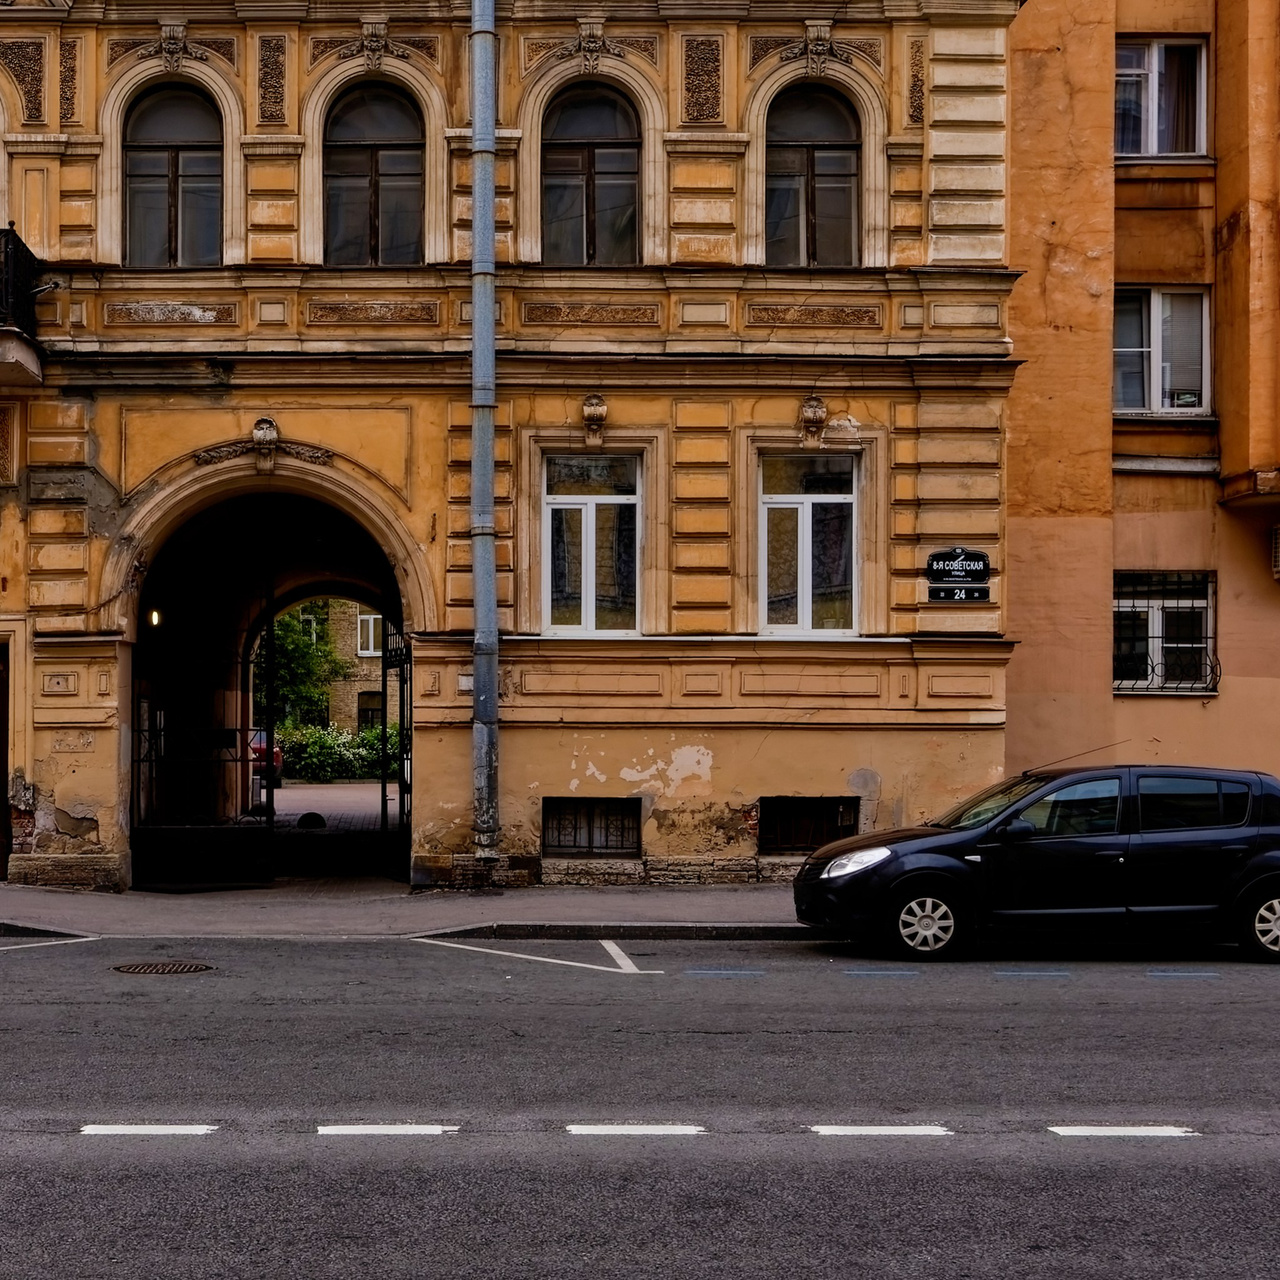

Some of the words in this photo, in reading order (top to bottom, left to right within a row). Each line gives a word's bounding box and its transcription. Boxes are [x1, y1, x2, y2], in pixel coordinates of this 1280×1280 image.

[932, 561, 944, 570] 8-Я
[944, 561, 984, 570] СОВЕТСКАЯ
[954, 589, 966, 600] 24
